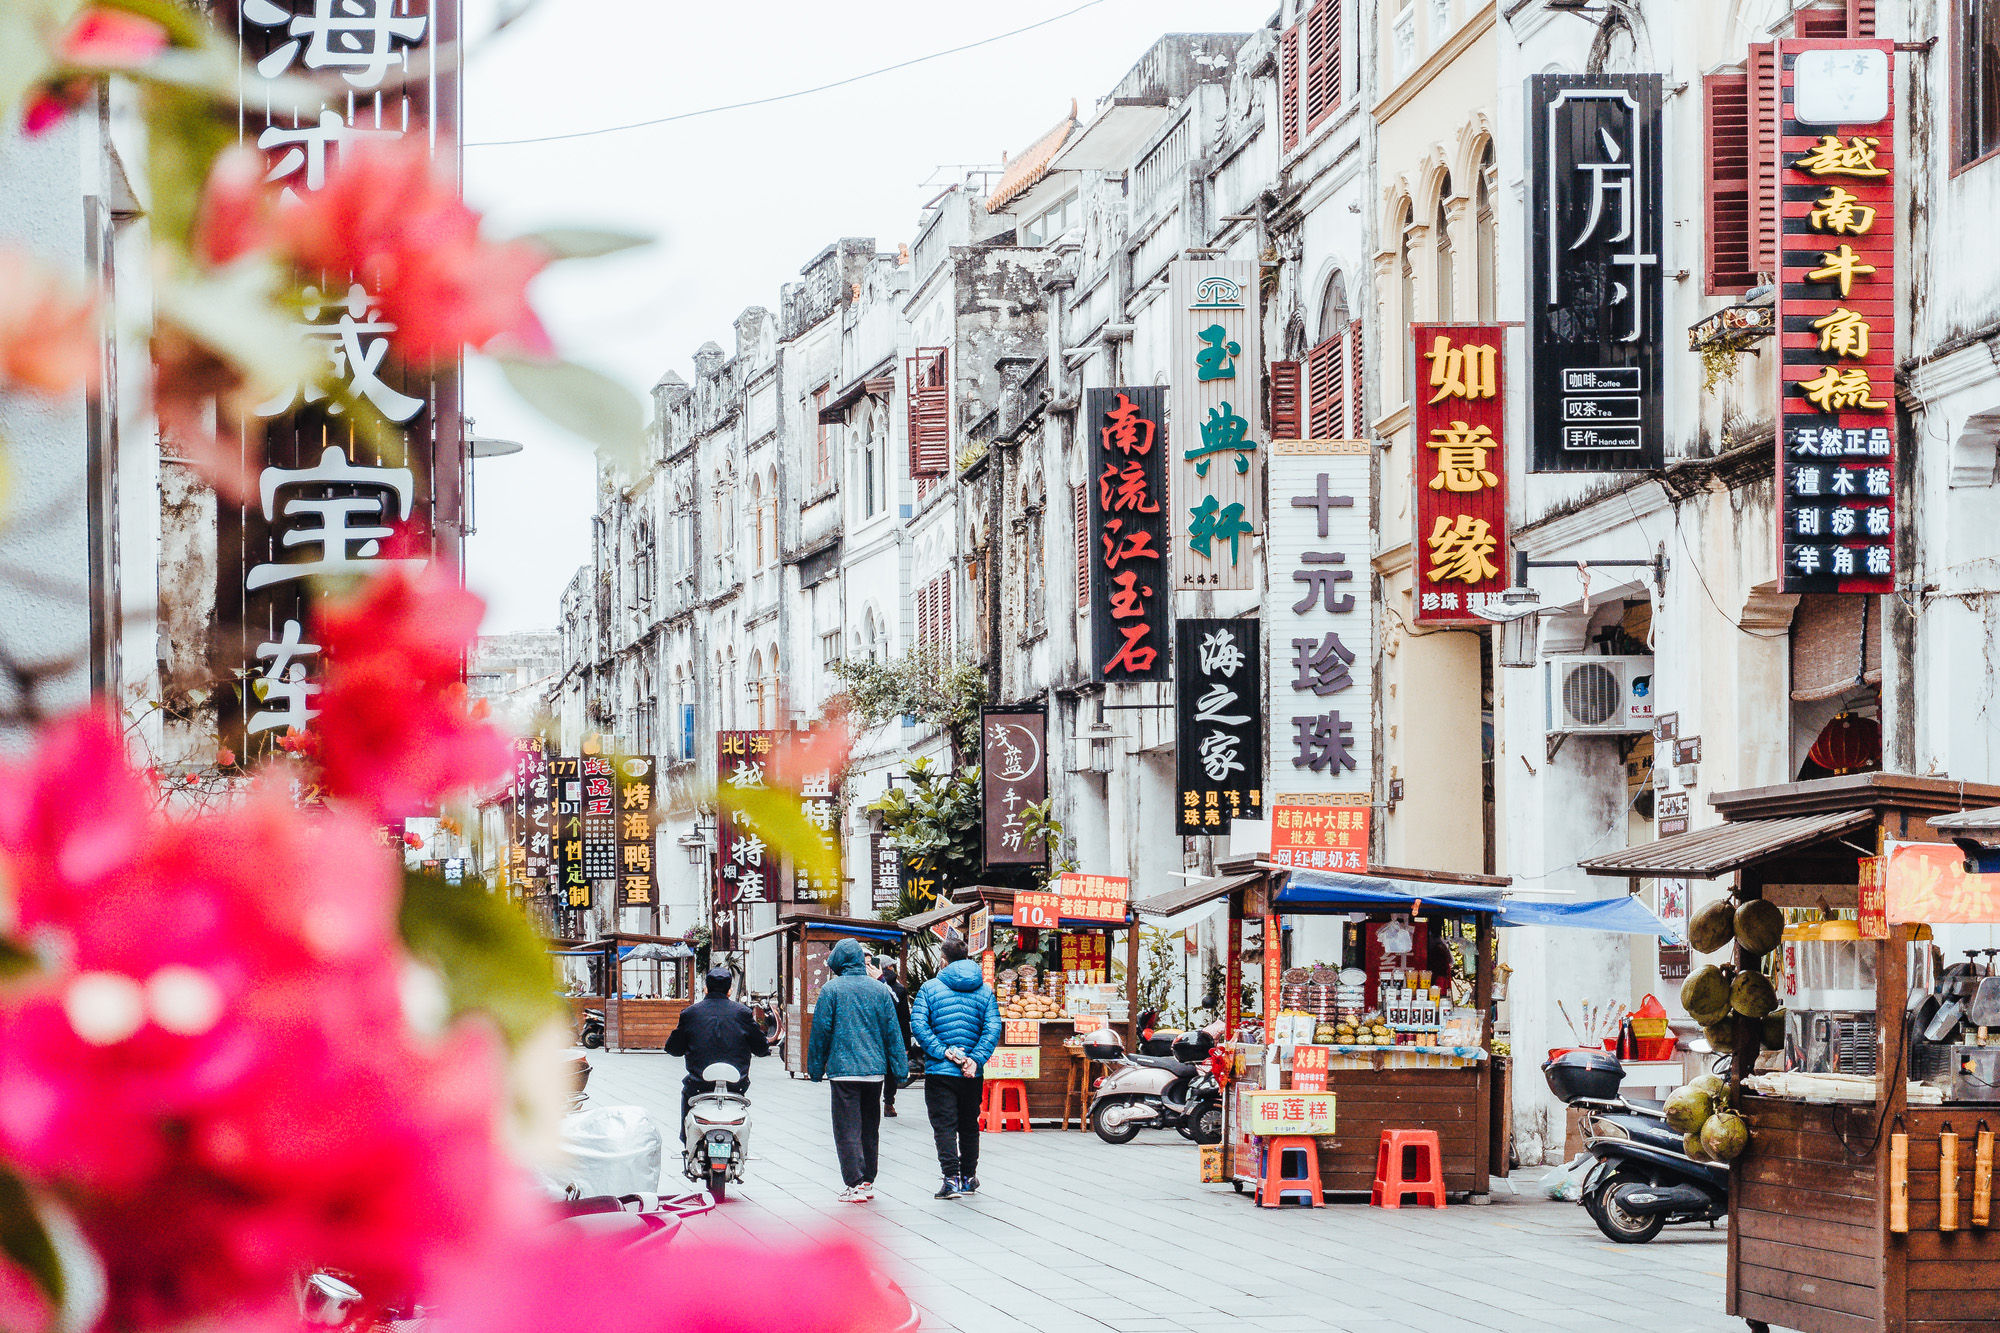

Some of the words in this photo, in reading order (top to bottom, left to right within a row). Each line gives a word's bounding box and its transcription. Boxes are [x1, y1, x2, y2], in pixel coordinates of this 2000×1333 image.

[1796, 136, 1889, 412] 越南牛角梳
[1569, 372, 1597, 387] 咖啡
[1569, 401, 1597, 416] 叹茶
[1185, 324, 1257, 566] 玉典轩
[1570, 430, 1598, 446] 手作
[1796, 427, 1891, 455] 天然正品
[1424, 336, 1498, 583] 如意缘
[1796, 466, 1891, 496] 檀木梳
[1797, 506, 1891, 535] 刮痧板
[1100, 393, 1160, 674] 南流江玉石
[1797, 545, 1891, 574] 羊角梳
[1421, 592, 1459, 611] 珍珠
[1291, 473, 1357, 775] 十元珍珠
[1195, 628, 1251, 781] 海之家
[1631, 705, 1654, 714] 长虹
[722, 736, 773, 754] 北海
[988, 723, 1025, 776] 浅蓝
[549, 760, 577, 775] 177
[582, 757, 615, 817] 蚝品王
[1001, 787, 1024, 852] 手工坊
[1277, 809, 1364, 831] 越南A+大腰果
[623, 782, 651, 903] 烤海鸭蛋
[1290, 830, 1316, 845] 批发
[1324, 831, 1350, 846] 零售
[565, 816, 590, 907] 个性定制
[878, 836, 898, 888] 单间出租
[1277, 849, 1361, 869] 网红椰奶冻
[723, 865, 738, 879] 烟
[1060, 898, 1125, 919] 老街最便宜
[1007, 1021, 1038, 1032] 火参果
[987, 1053, 1034, 1068] 榴莲糕
[1296, 1048, 1326, 1069] 火参果
[1260, 1098, 1328, 1121] 榴莲糕
